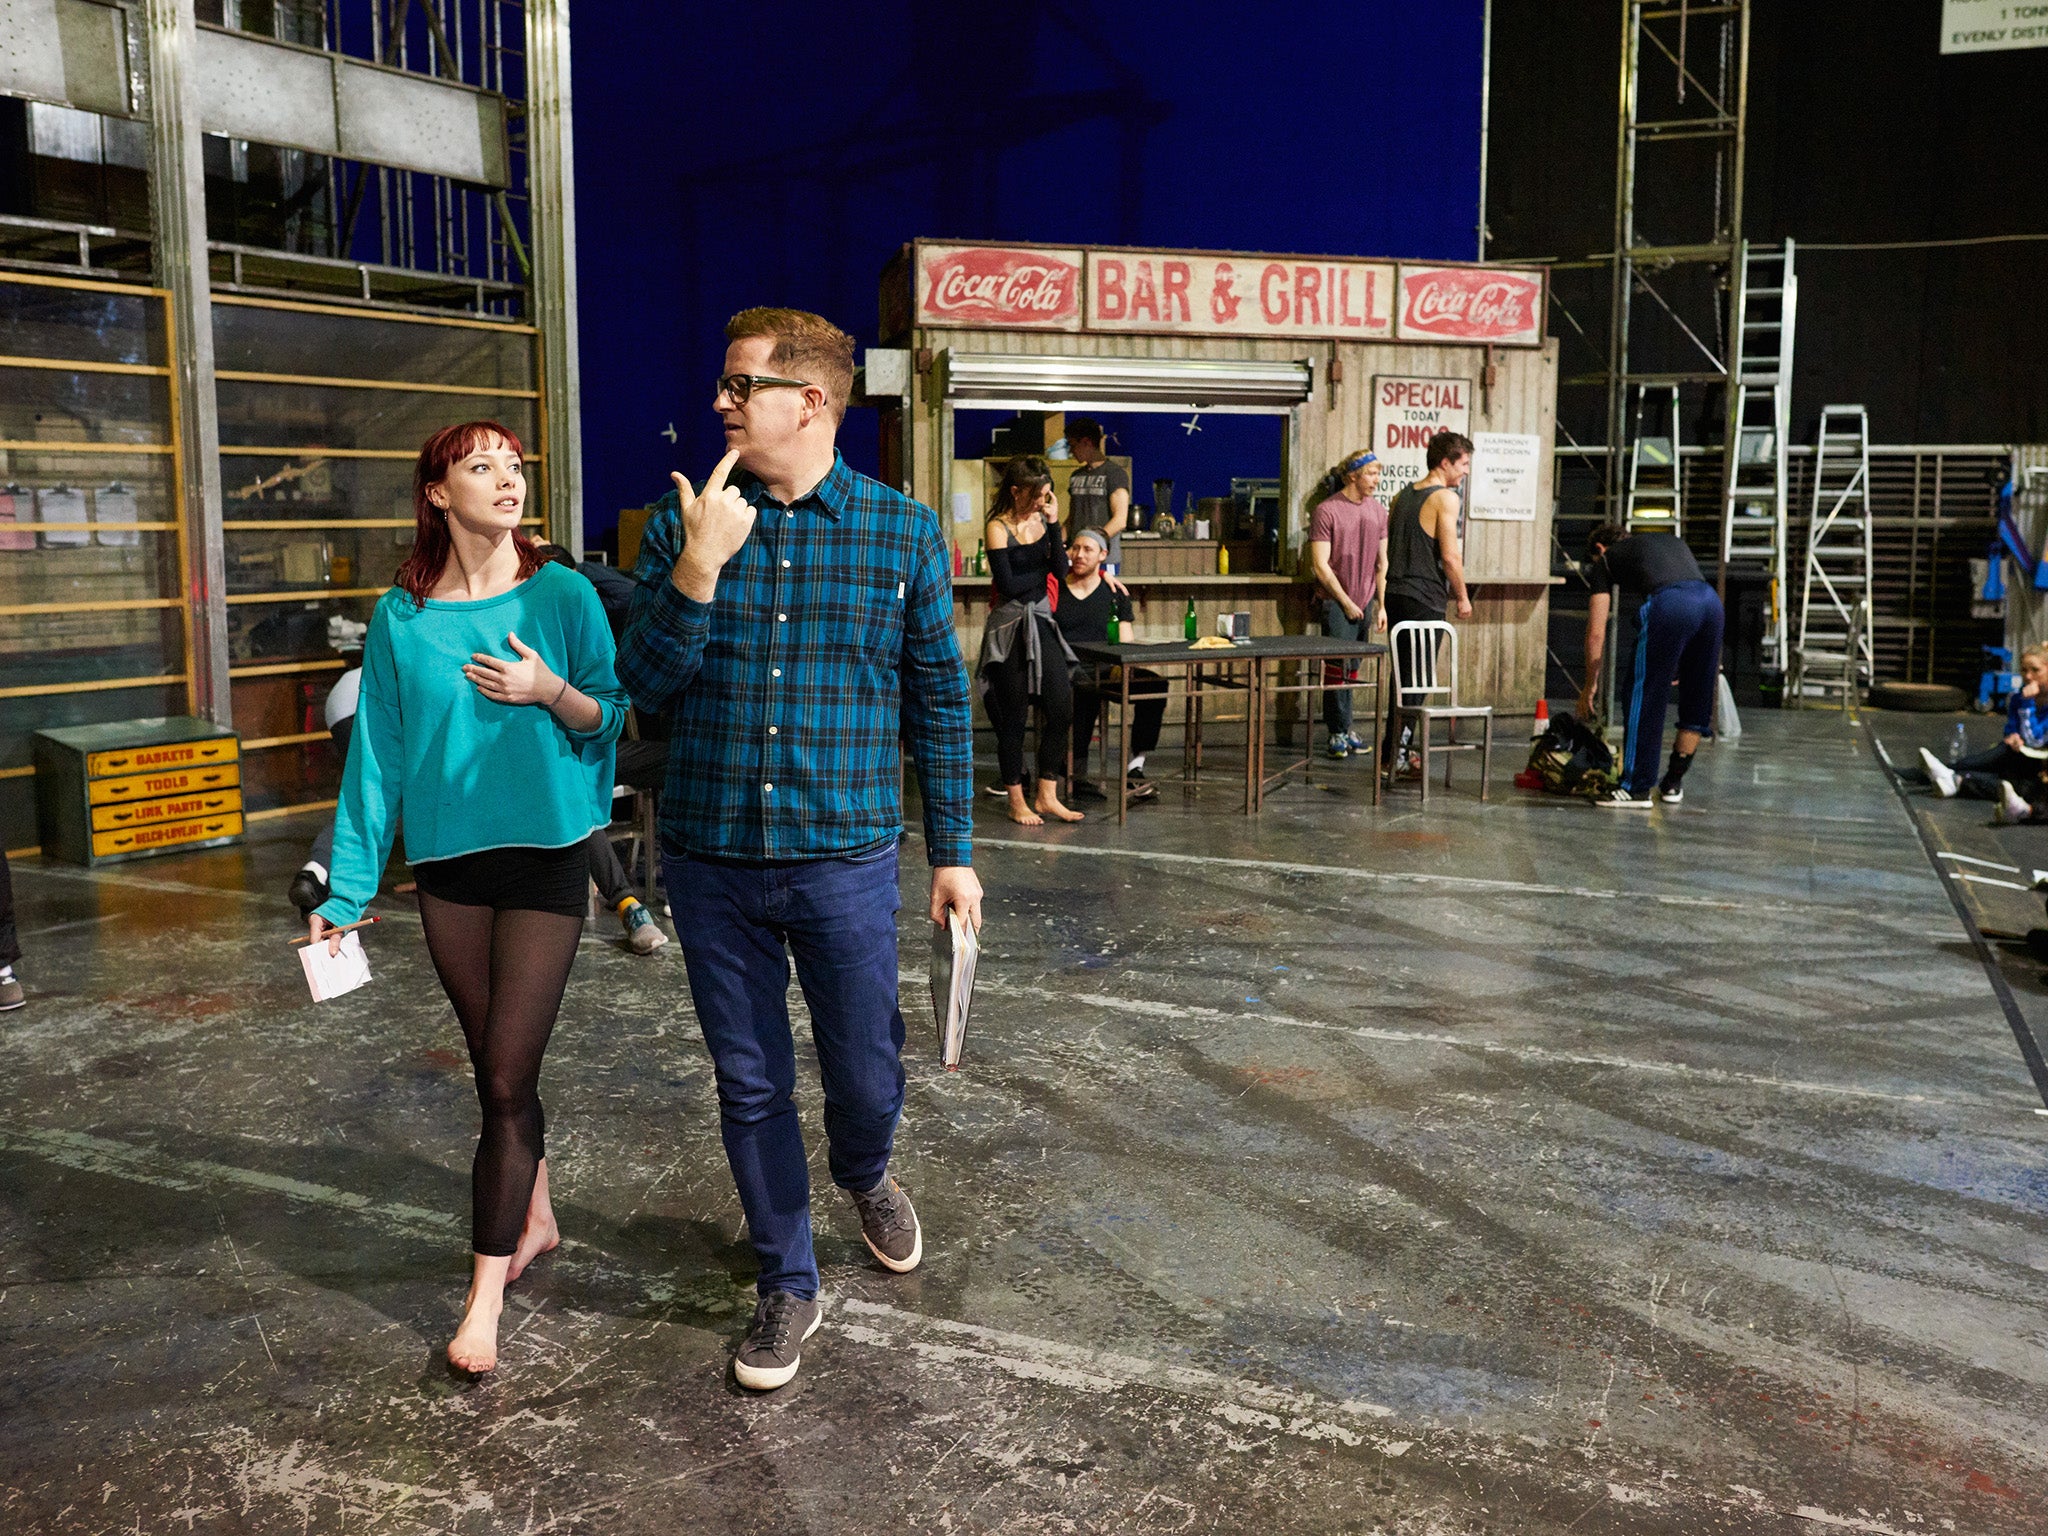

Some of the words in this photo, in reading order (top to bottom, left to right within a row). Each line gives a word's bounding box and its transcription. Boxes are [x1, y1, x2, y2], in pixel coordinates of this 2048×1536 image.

[1952, 30, 2007, 43] EVENLY
[935, 264, 1069, 313] Coca-Cola
[1097, 259, 1193, 323] BAR
[1209, 262, 1243, 325] &
[1259, 264, 1387, 329] GRILL
[1412, 280, 1530, 327] Coca-Cola
[1382, 382, 1463, 409] SPECIAL
[1404, 410, 1440, 422] TODAY
[1378, 464, 1419, 477] URGER
[136, 749, 193, 765] GASKETS
[145, 776, 188, 791] TOOLS
[135, 806, 162, 819] LINK
[168, 801, 203, 814] PARTS
